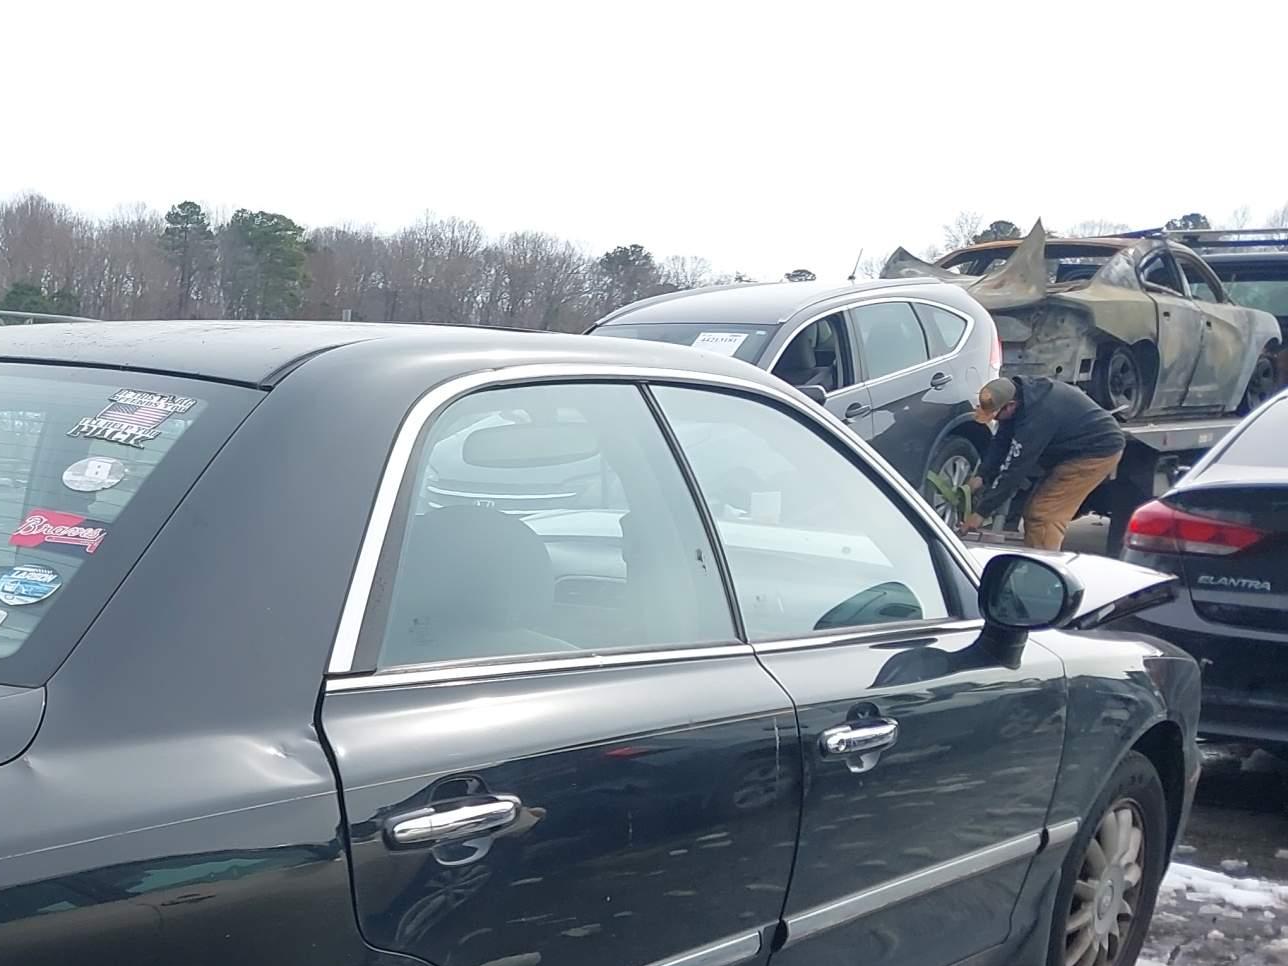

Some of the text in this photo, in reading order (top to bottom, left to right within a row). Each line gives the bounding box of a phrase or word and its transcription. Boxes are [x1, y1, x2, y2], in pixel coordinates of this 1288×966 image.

[102, 421, 133, 432] HELP
[133, 427, 161, 437] YOU
[66, 426, 145, 450] PACK
[1198, 575, 1271, 591] ELANTRA
